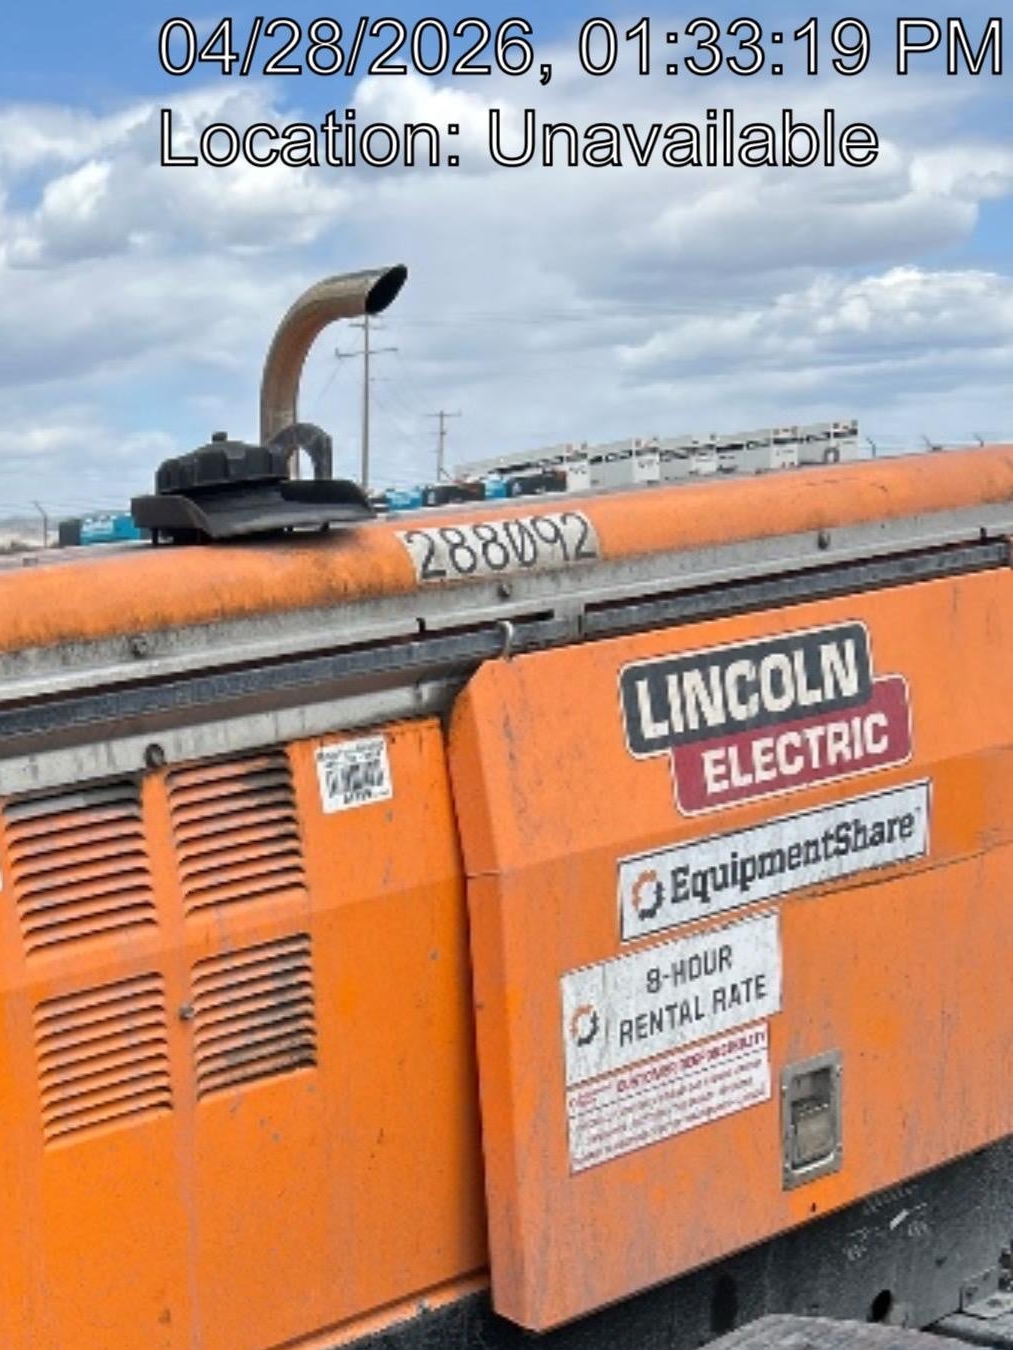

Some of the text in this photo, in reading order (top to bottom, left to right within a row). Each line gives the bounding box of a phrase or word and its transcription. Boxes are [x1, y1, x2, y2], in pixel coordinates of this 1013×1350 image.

[405, 511, 597, 580] 288092
[636, 638, 860, 740] LINCOLN
[701, 712, 890, 795] ELECTRIC
[670, 817, 917, 904] EquipmentShare
[646, 944, 733, 994] 8-HOUR
[619, 973, 768, 1047] RENTAL RATE
